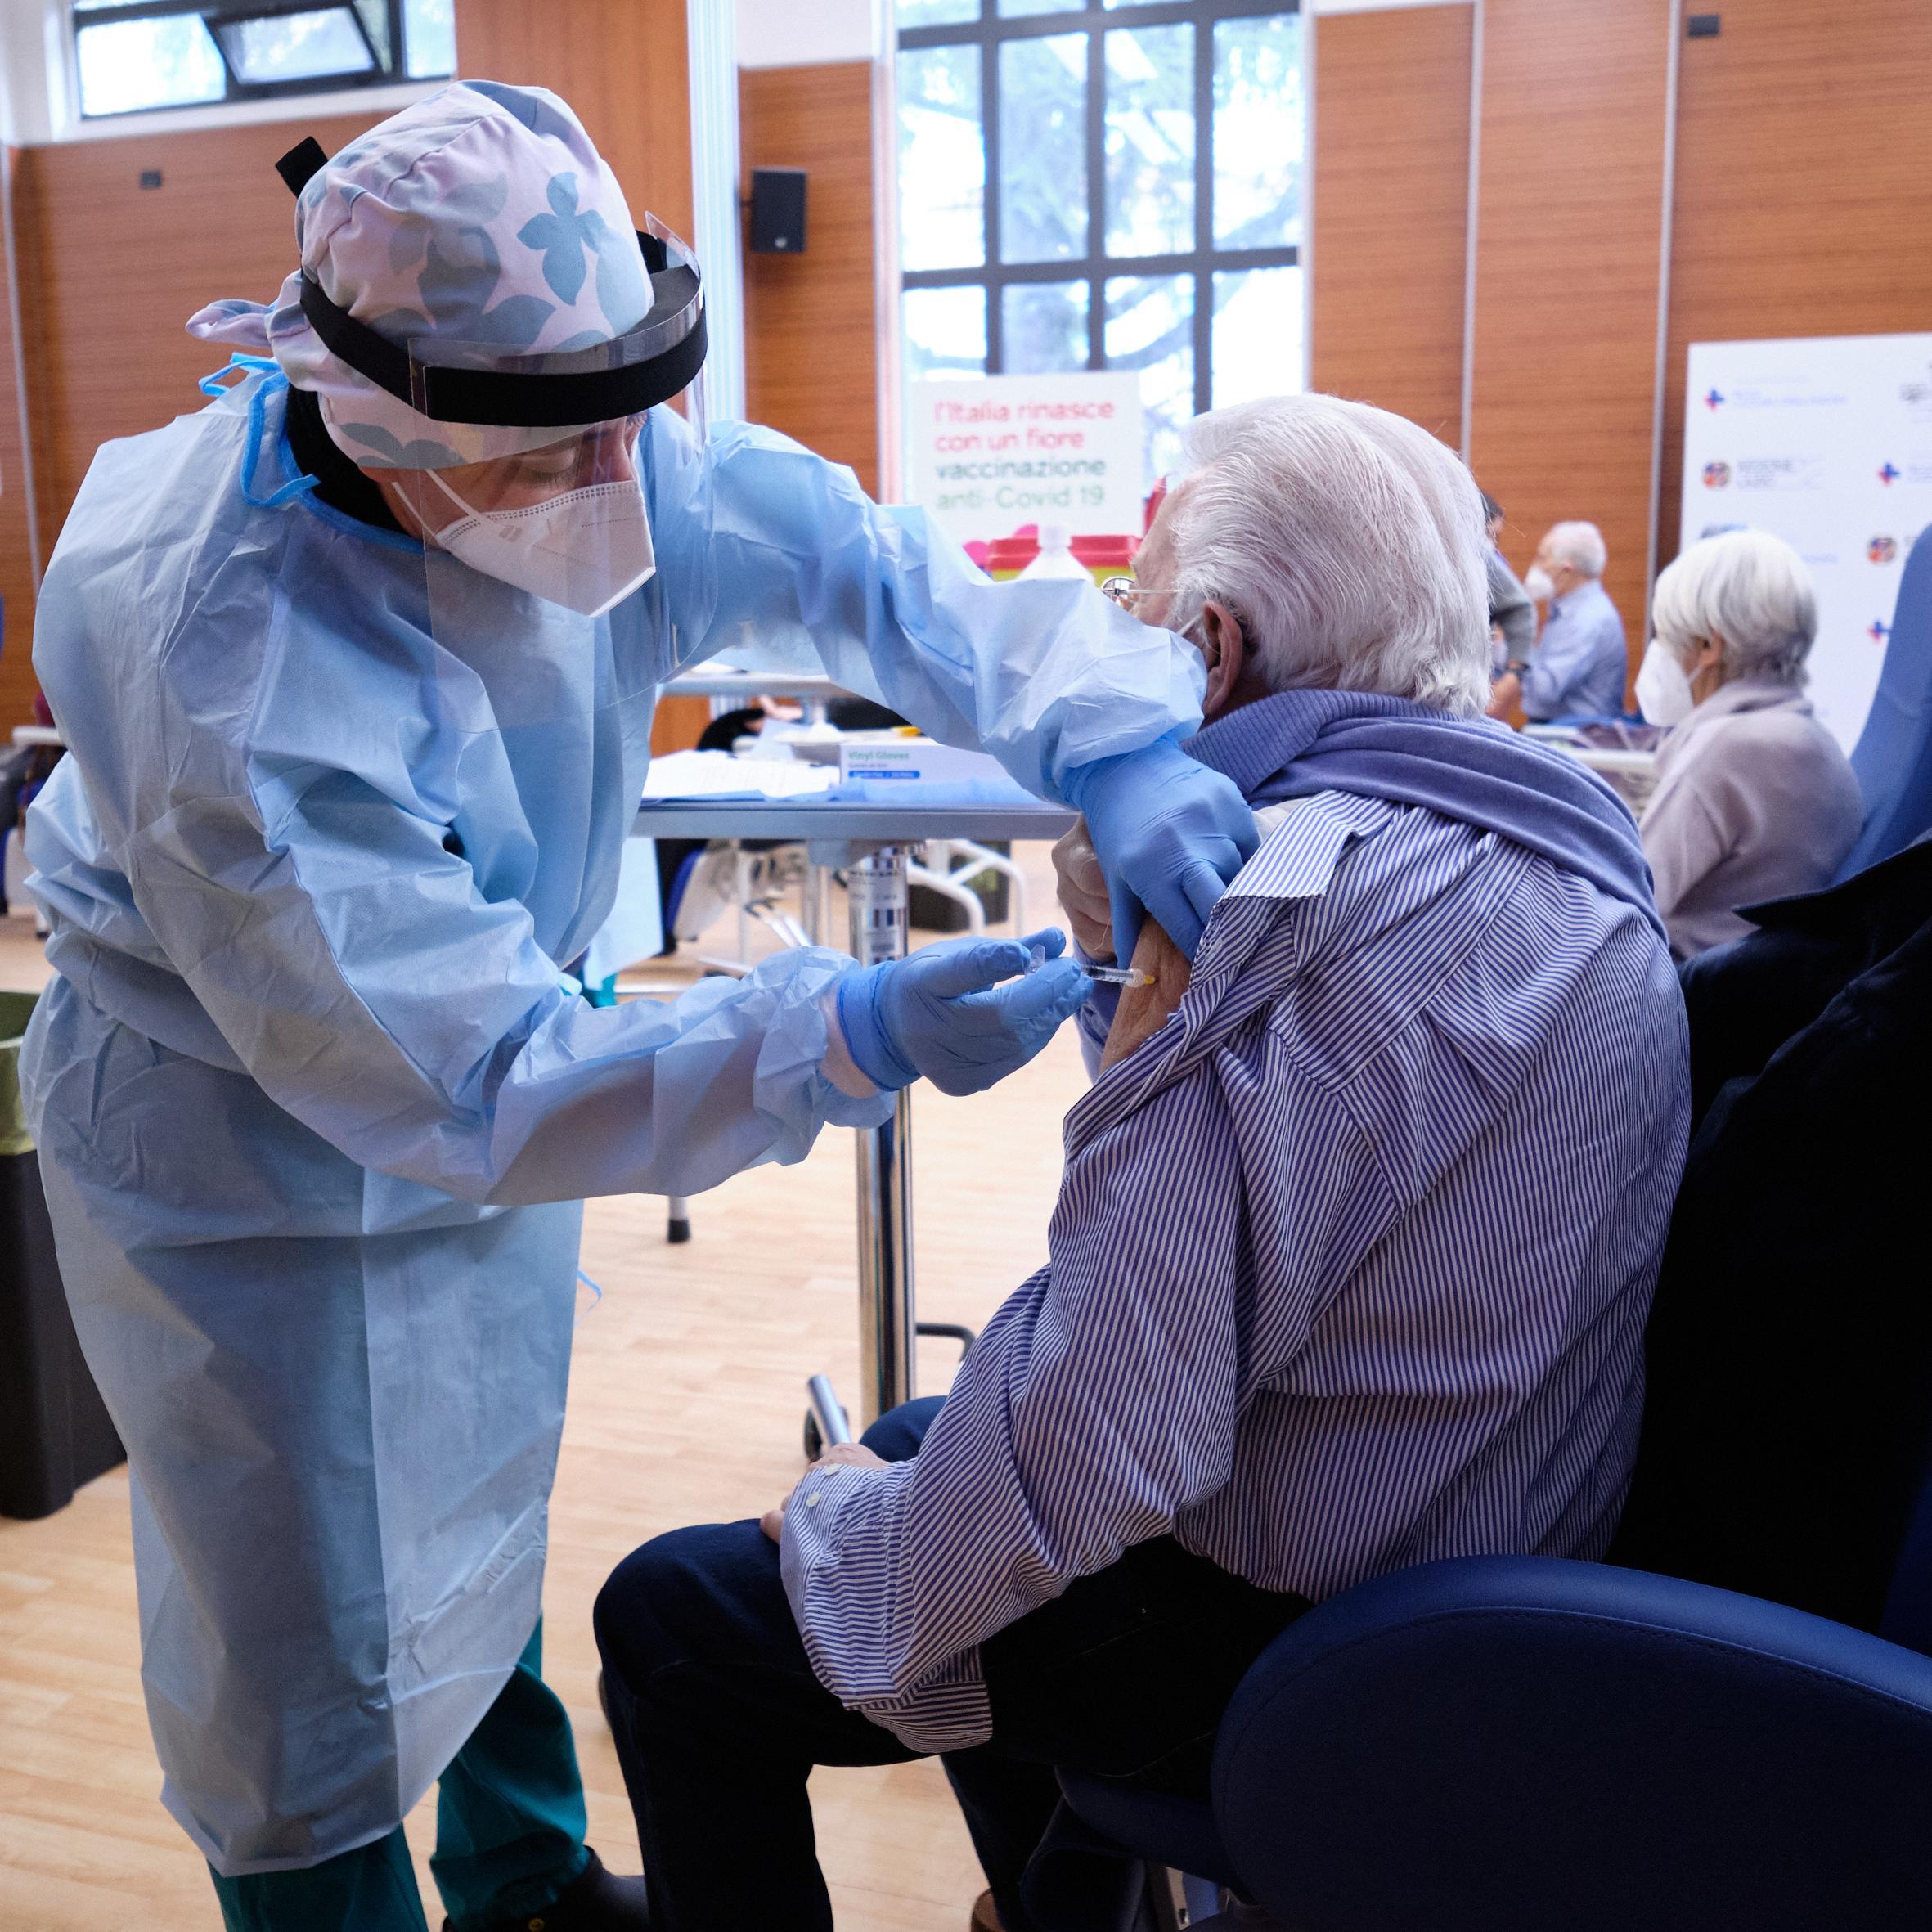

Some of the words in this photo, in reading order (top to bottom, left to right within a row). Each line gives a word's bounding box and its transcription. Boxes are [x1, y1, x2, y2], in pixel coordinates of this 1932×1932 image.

[1019, 399, 1114, 420] rinasce
[935, 435, 980, 452] con
[988, 434, 1018, 451] un
[1027, 428, 1085, 449] fiore
[937, 456, 1106, 479] vaccinazione
[937, 486, 1070, 509] anti-Covid
[1081, 485, 1106, 506] 19
[848, 751, 874, 761] Vinyl
[876, 751, 910, 759] Gloves
